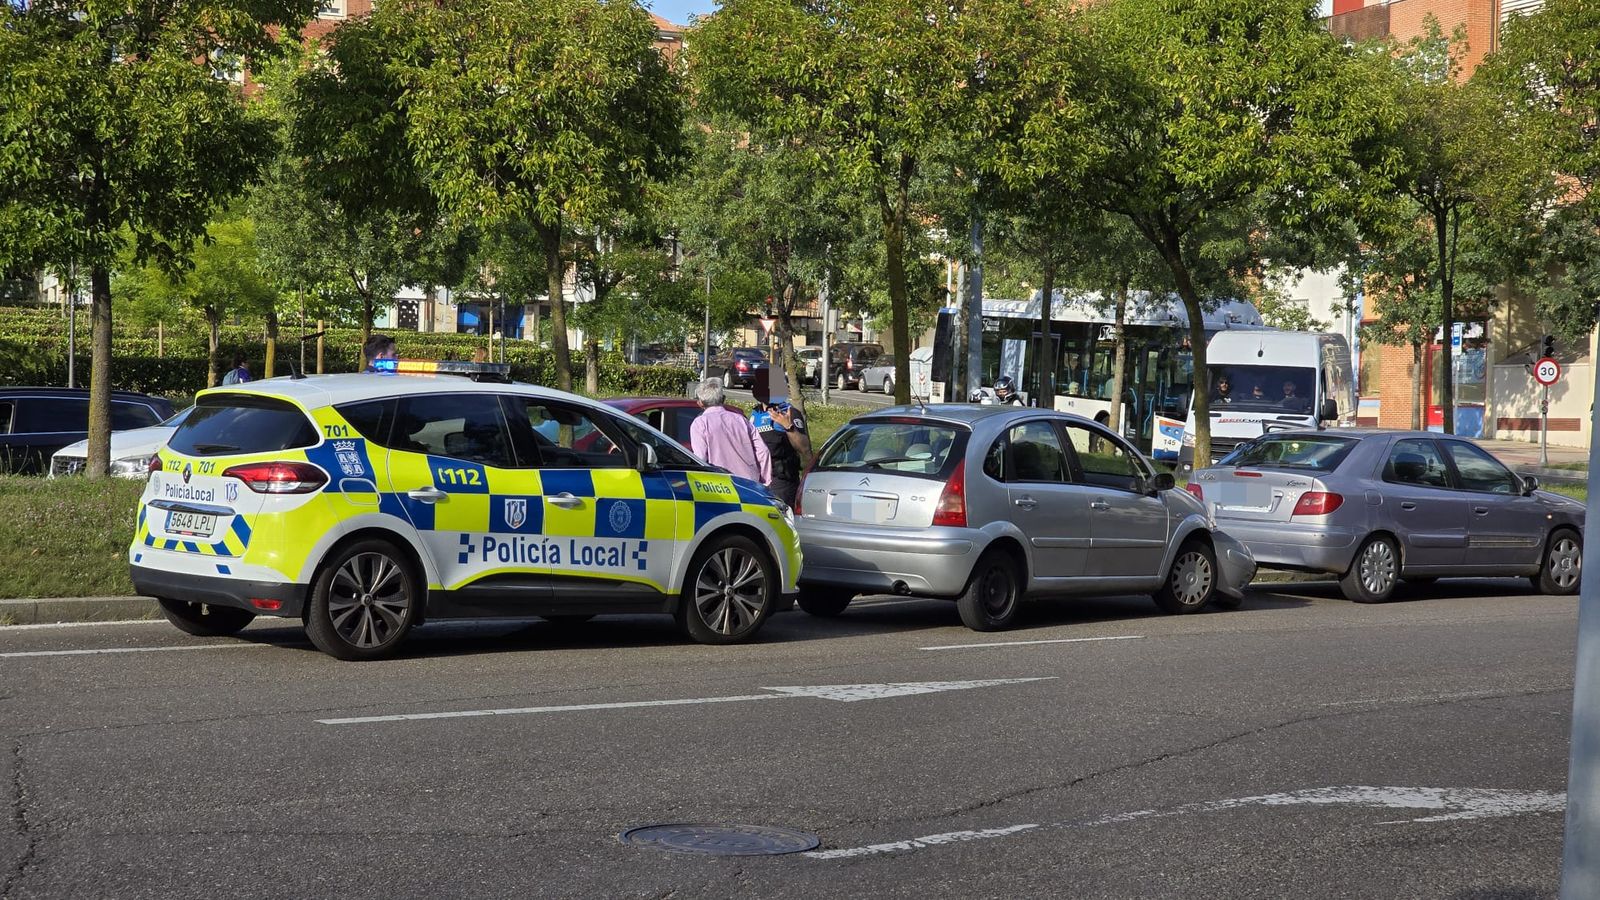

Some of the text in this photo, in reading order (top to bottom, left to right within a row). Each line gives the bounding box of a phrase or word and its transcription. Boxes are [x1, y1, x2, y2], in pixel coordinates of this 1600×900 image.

[1540, 367, 1555, 376] 30
[324, 424, 349, 437] 701
[1163, 438, 1176, 446] 145
[168, 460, 181, 471] 112
[198, 461, 216, 474] 701
[444, 468, 482, 485] 112
[171, 512, 211, 531] 5648 LPL
[482, 535, 626, 567] Policía Local
